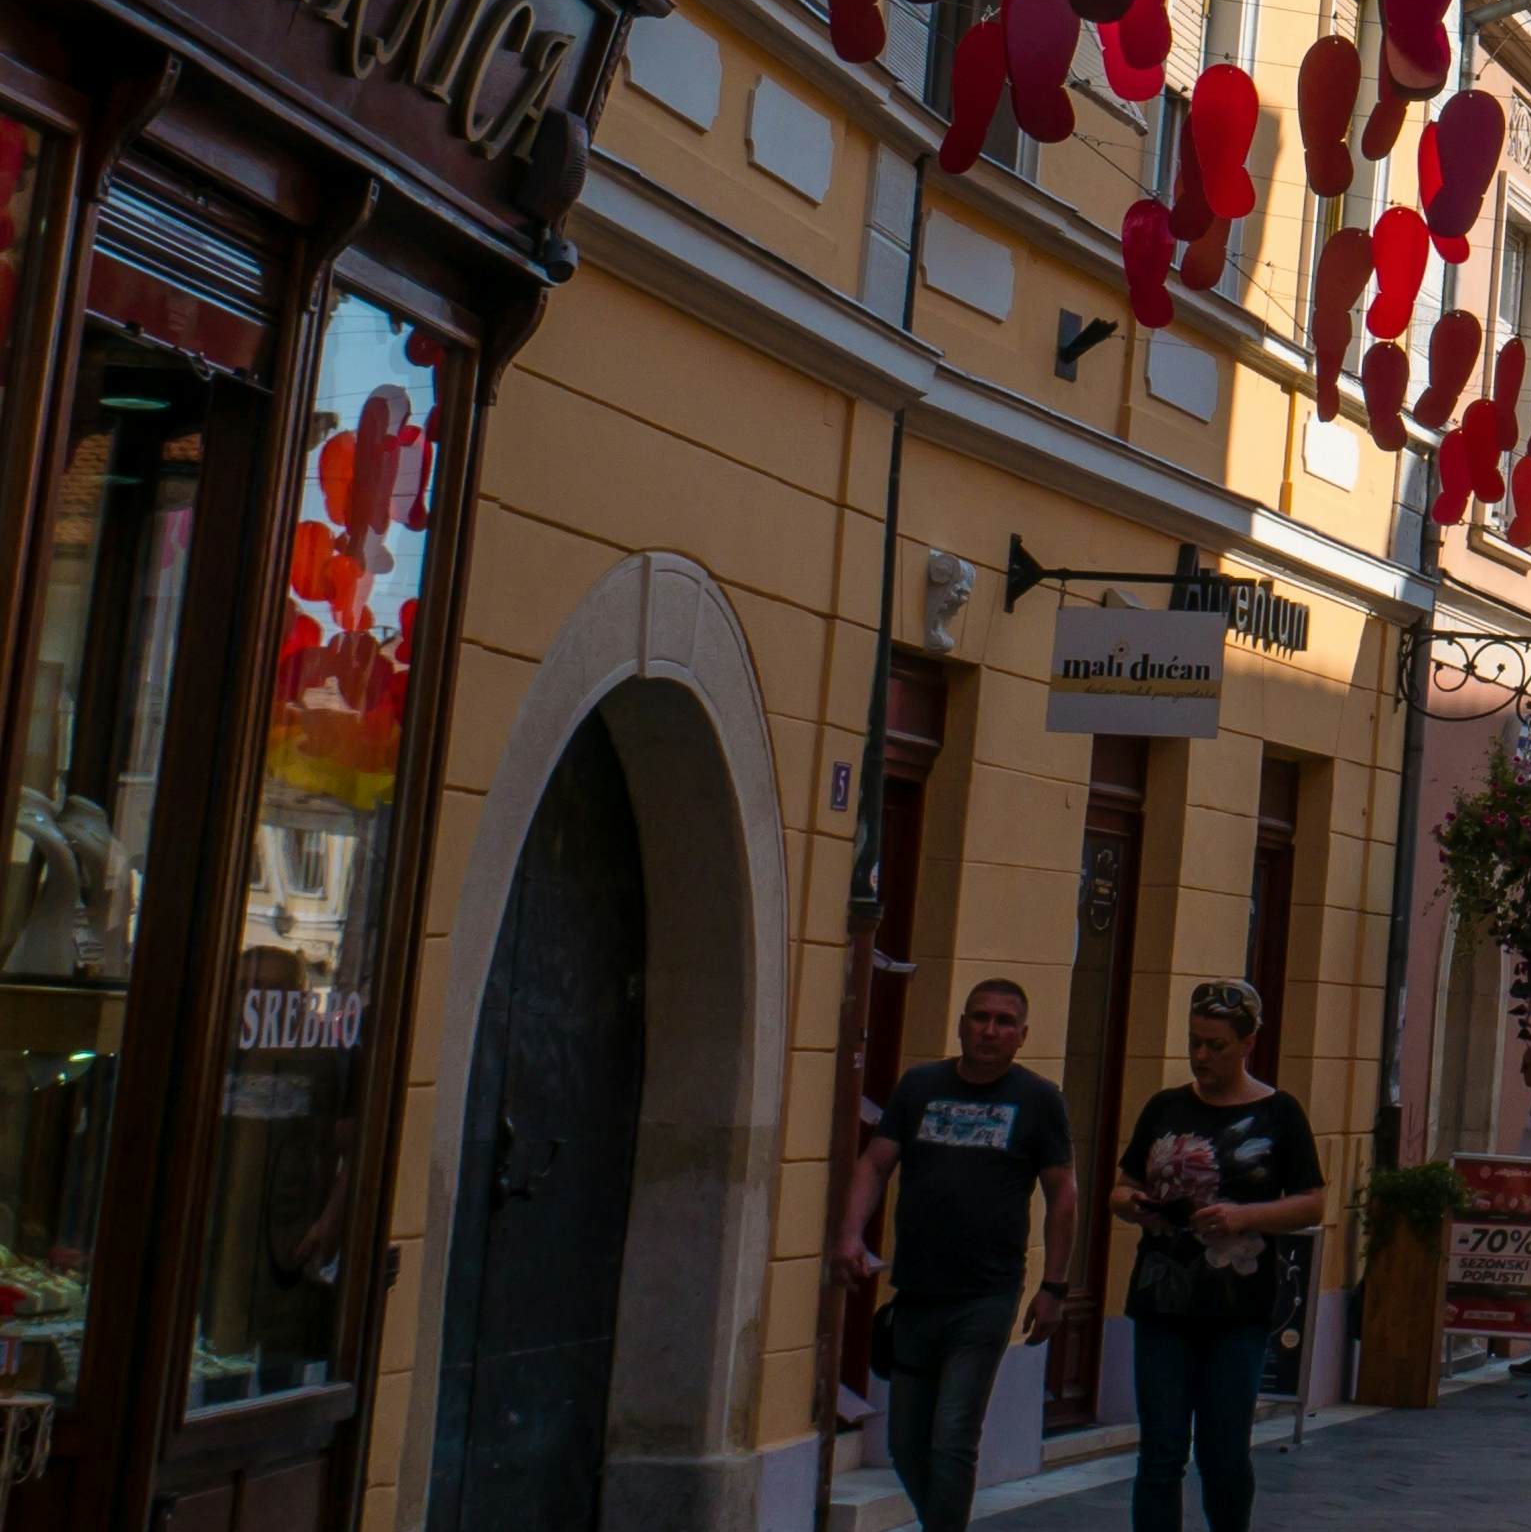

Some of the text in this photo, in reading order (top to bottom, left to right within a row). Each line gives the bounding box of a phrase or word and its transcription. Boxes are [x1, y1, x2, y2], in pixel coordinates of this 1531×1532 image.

[1062, 648, 1210, 681] mali dućan
[240, 988, 362, 1050] SREBRO
[1459, 1257, 1530, 1272] SEZONSKI
[1461, 1270, 1525, 1284] POPUSTI
